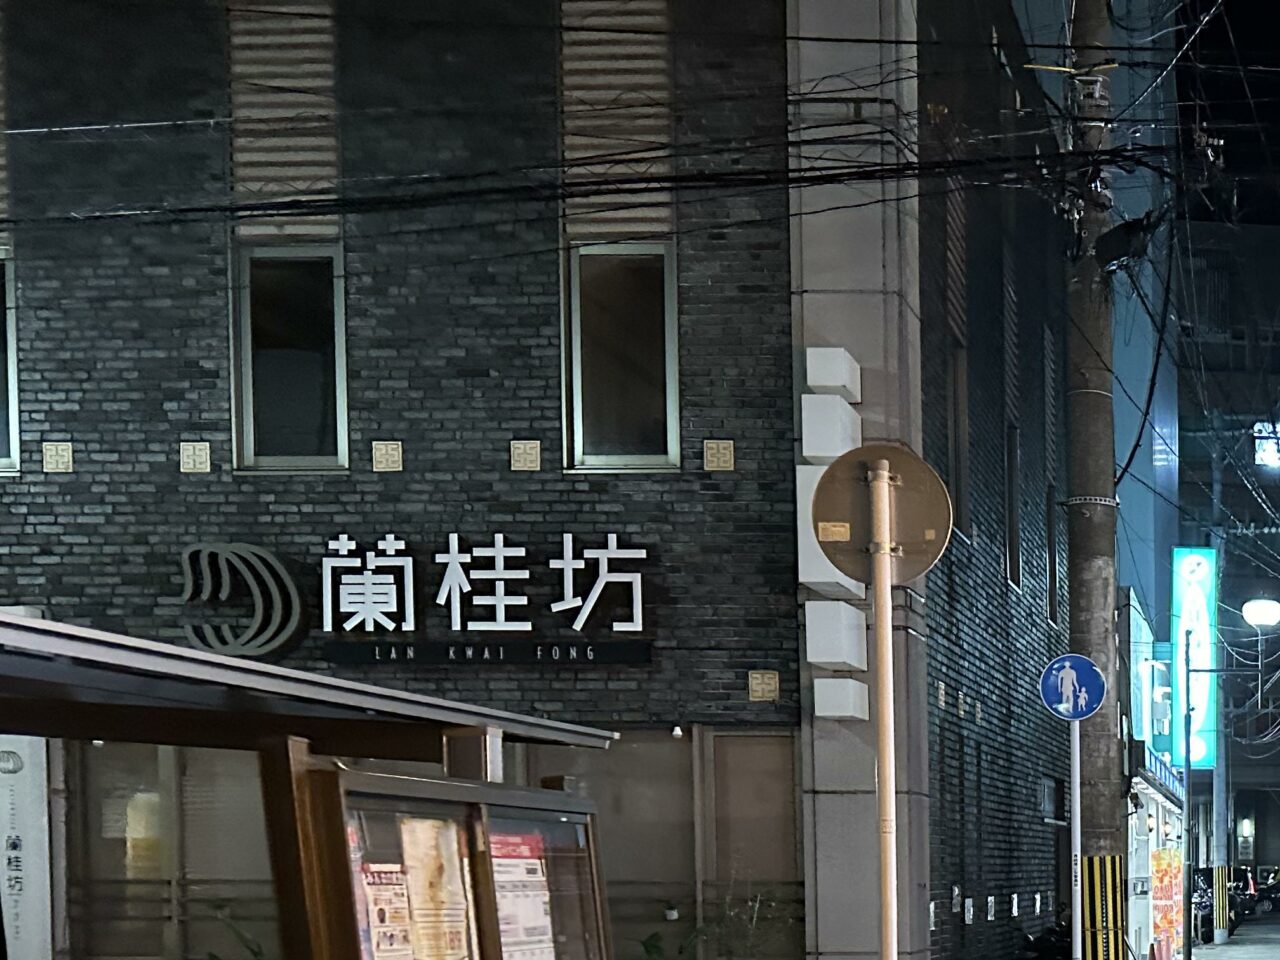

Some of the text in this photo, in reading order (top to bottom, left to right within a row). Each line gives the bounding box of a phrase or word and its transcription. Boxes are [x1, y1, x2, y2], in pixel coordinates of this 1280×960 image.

[322, 532, 648, 632] 蘭桂坊
[374, 646, 597, 661] LAN KWAI FONG
